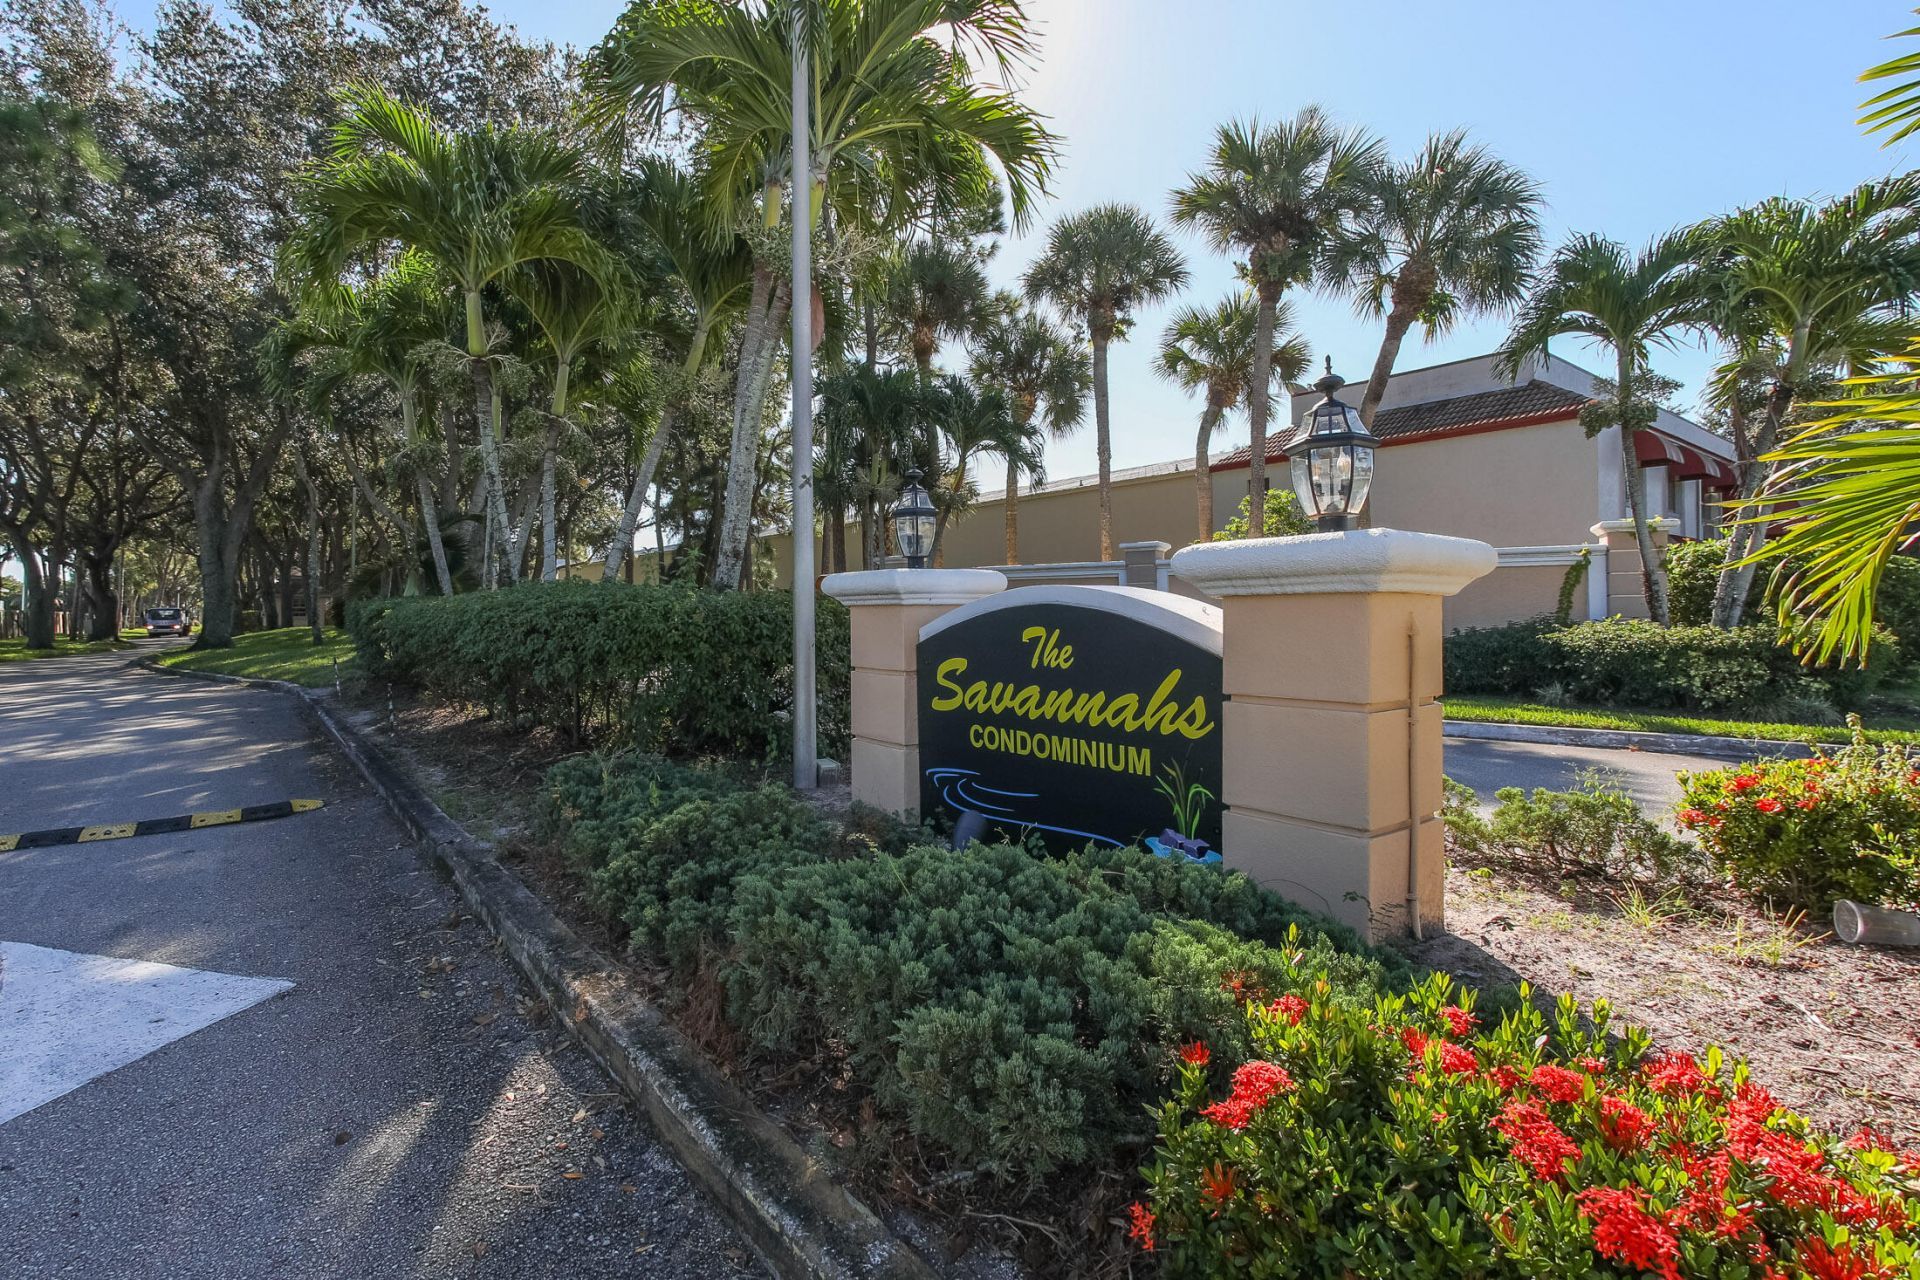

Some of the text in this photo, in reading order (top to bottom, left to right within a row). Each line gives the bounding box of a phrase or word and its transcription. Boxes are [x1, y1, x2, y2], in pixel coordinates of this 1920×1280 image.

[1022, 626, 1074, 669] The
[931, 657, 1214, 739] Savannahs
[969, 724, 1152, 777] CONDOMINIUM
